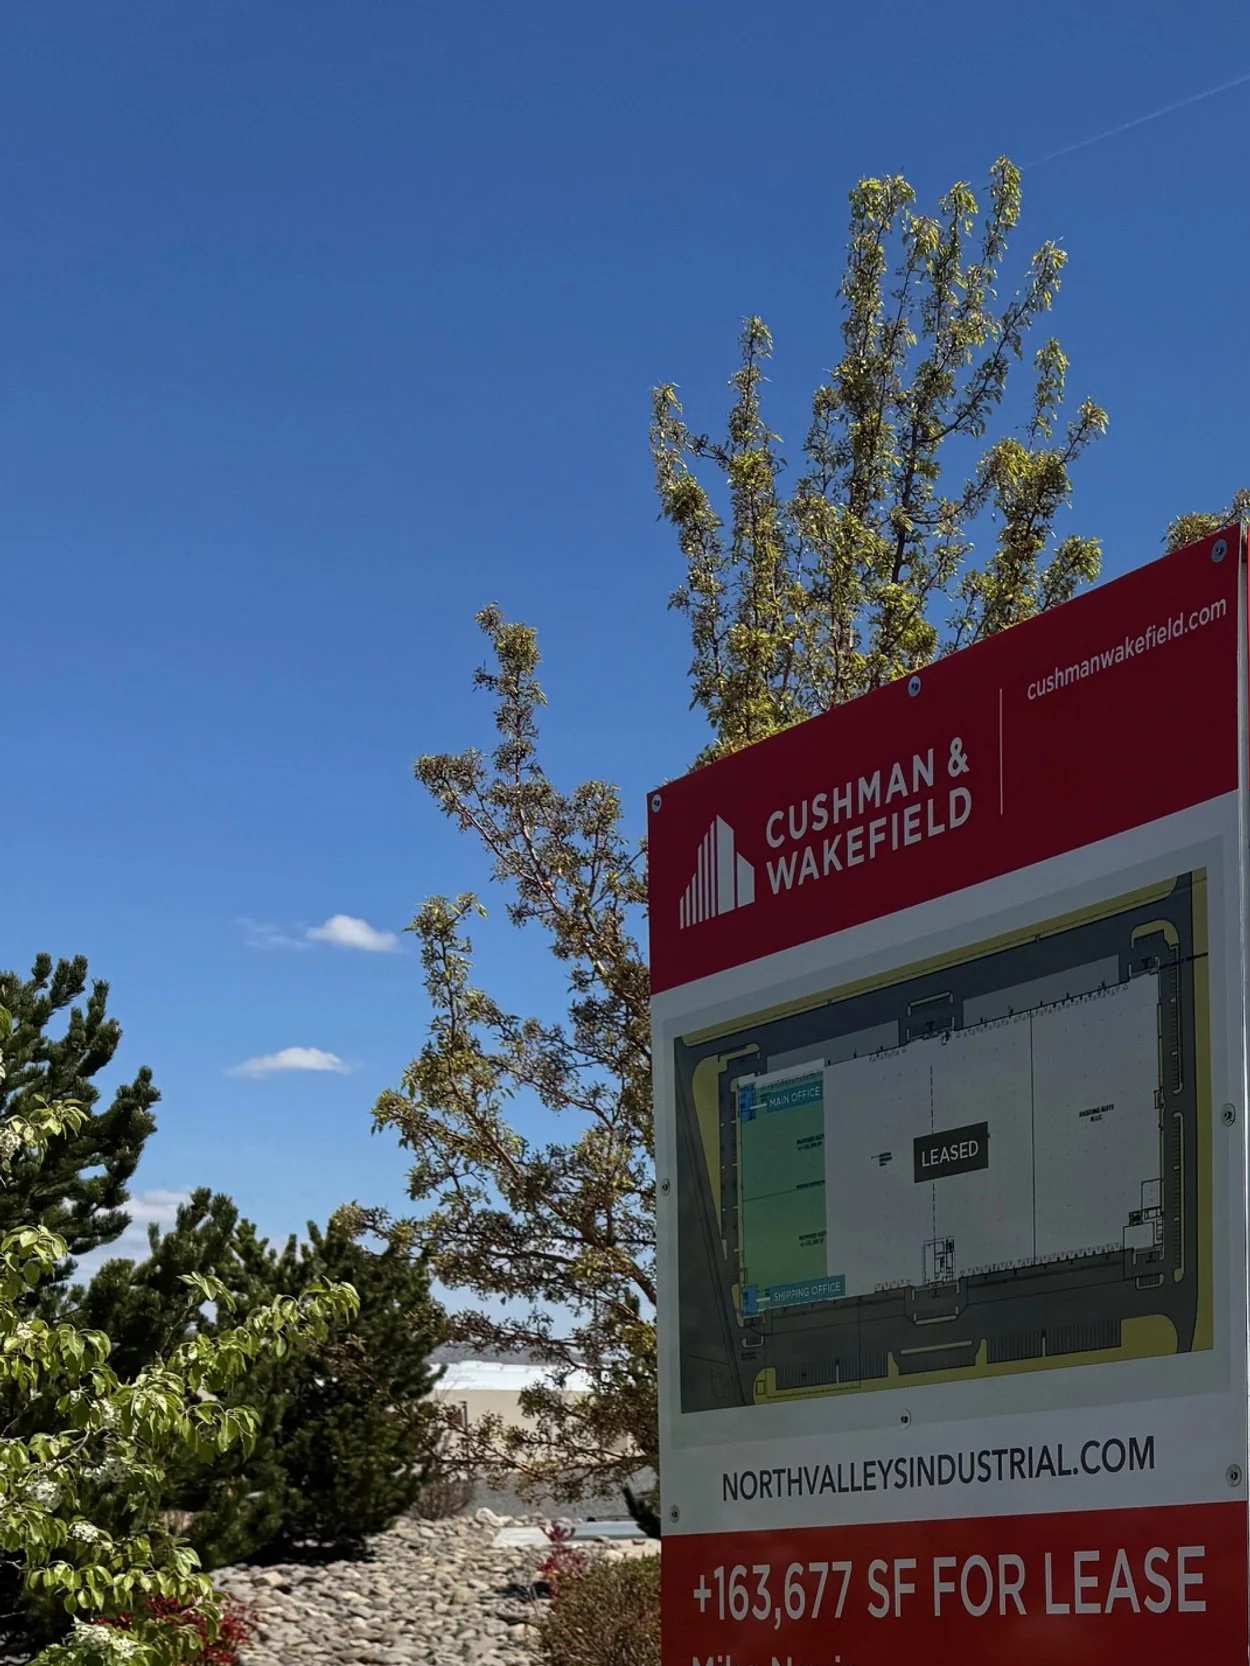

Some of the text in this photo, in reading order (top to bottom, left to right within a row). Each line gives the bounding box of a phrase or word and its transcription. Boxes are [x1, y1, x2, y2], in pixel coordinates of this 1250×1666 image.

[1027, 599, 1226, 701] cushmanwakefield.com
[766, 737, 969, 849] CUSHMAN &
[766, 786, 972, 895] WAKEFIELD
[770, 1087, 820, 1107] MAIN OFFICE
[922, 1141, 978, 1167] LEASED
[775, 1282, 840, 1301] SHIPPING OFFICE
[723, 1436, 1155, 1501] NORTHVALLEYSINDUSTRIAL.COM
[694, 1546, 1206, 1630] +163,677 SF FOR LEASE
